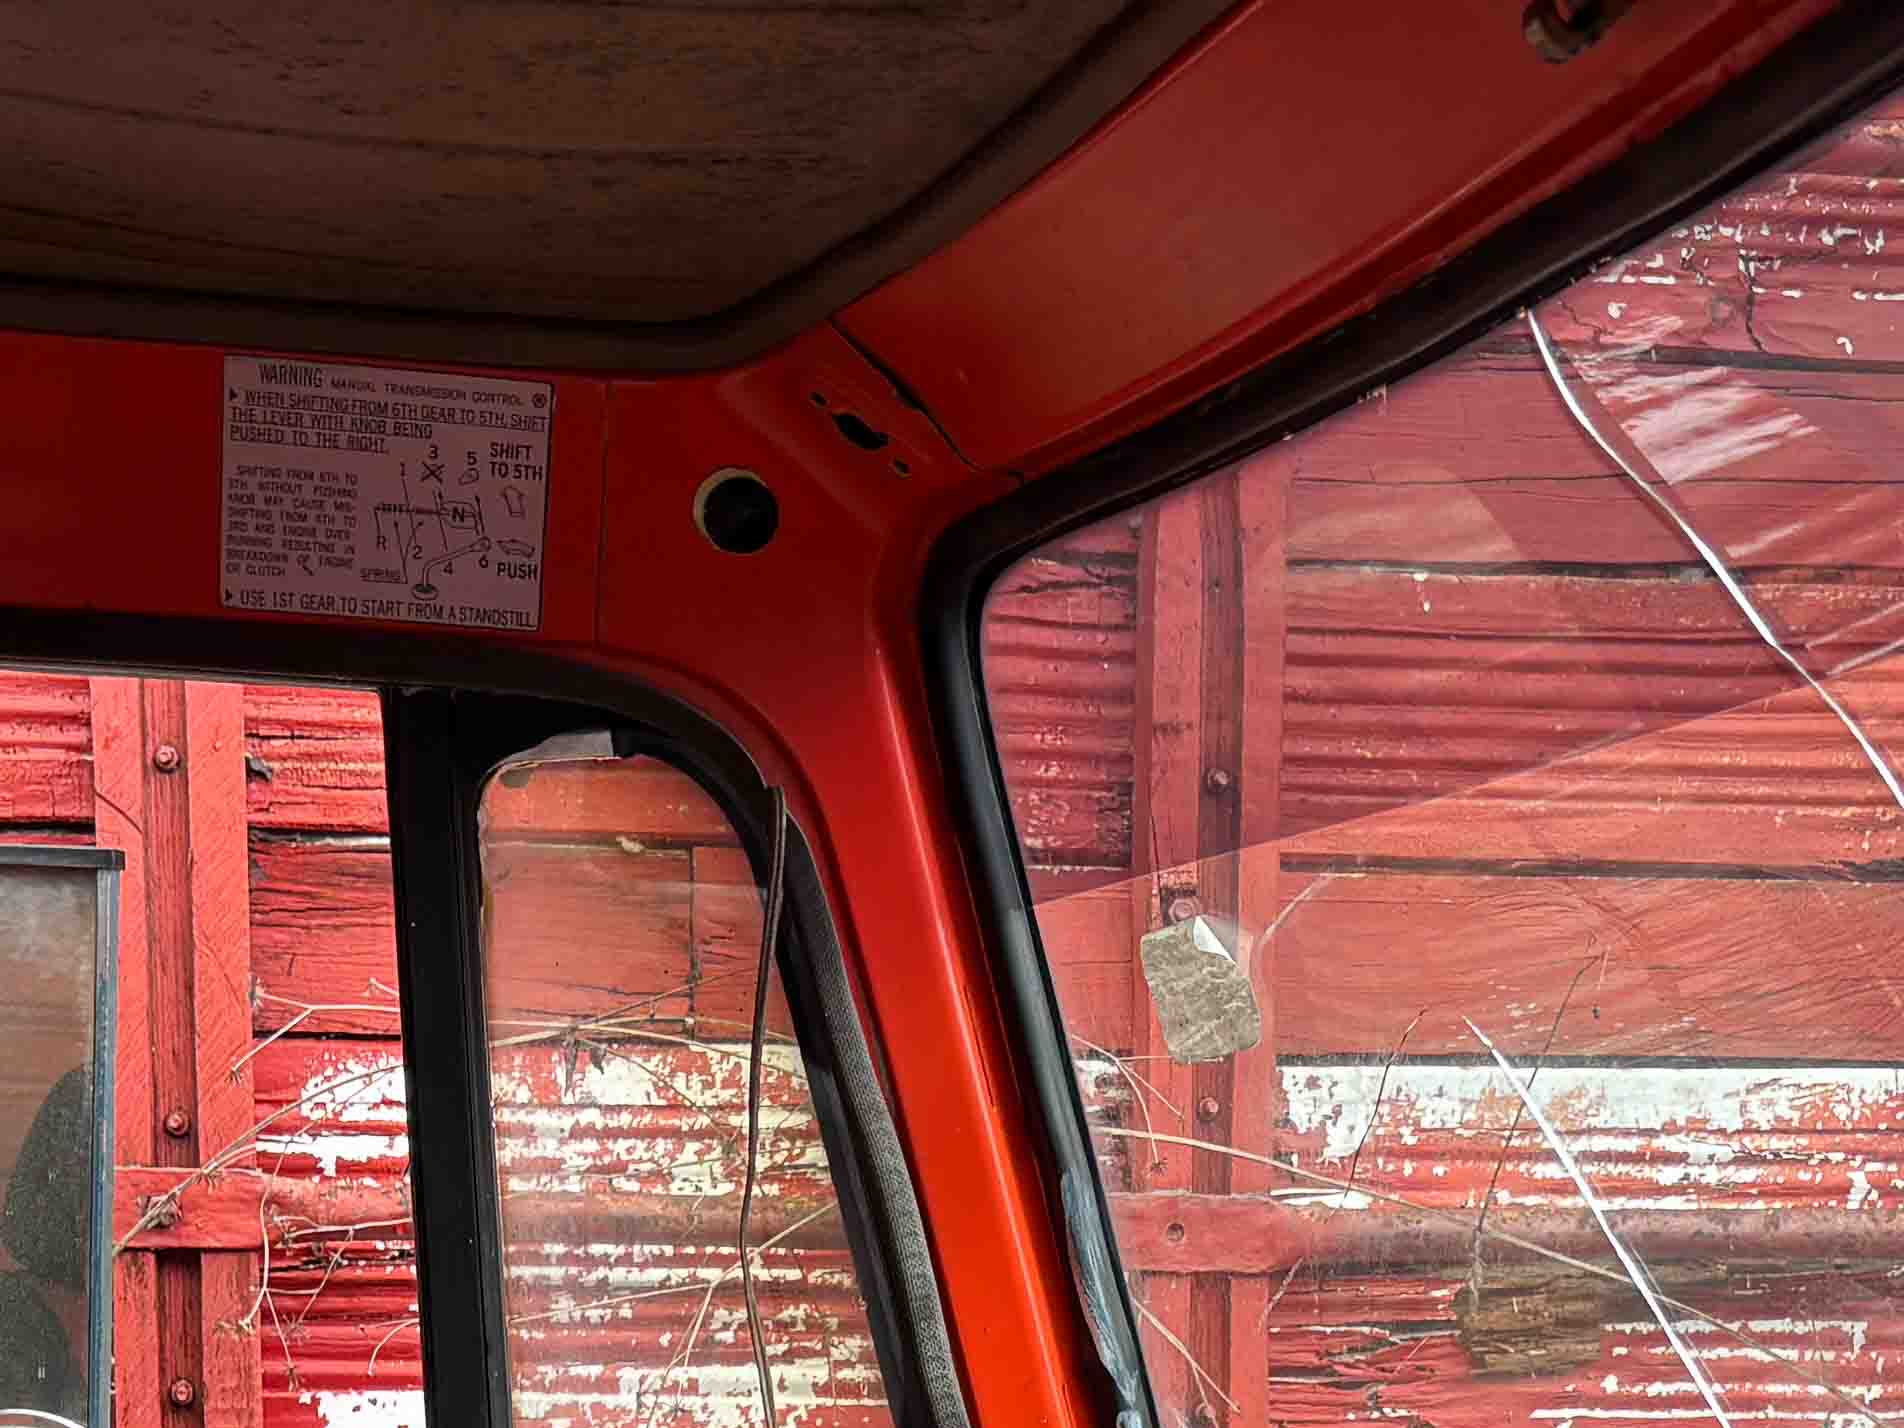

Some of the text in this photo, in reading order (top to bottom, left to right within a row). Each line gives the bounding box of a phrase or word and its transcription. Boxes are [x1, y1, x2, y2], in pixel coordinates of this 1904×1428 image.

[258, 363, 323, 389] WARNING
[245, 390, 284, 407] WHEN
[288, 393, 348, 413] SHIFTING
[350, 399, 388, 417] FROM
[421, 404, 456, 422] GEAR
[458, 407, 475, 423] TO
[510, 414, 548, 432] SHIFT
[230, 406, 433, 440] THE LEVER WITH KNOB BEING
[229, 423, 284, 443] PUSHED
[292, 428, 310, 446] TO
[316, 430, 341, 448] THE
[428, 444, 440, 460] 3
[466, 451, 479, 467] 5
[489, 441, 534, 462] SHIFT
[489, 461, 544, 482] TO 5TH
[451, 506, 466, 524] N
[375, 534, 388, 552] R
[411, 544, 424, 561] 2
[443, 560, 455, 576] 4
[478, 554, 490, 570] 6
[495, 560, 539, 581] PUSH
[239, 588, 266, 608] USE
[300, 593, 336, 613] GEAR
[339, 596, 358, 615] TO
[360, 598, 402, 618] START
[407, 602, 445, 621] FROM
[447, 605, 458, 620] A
